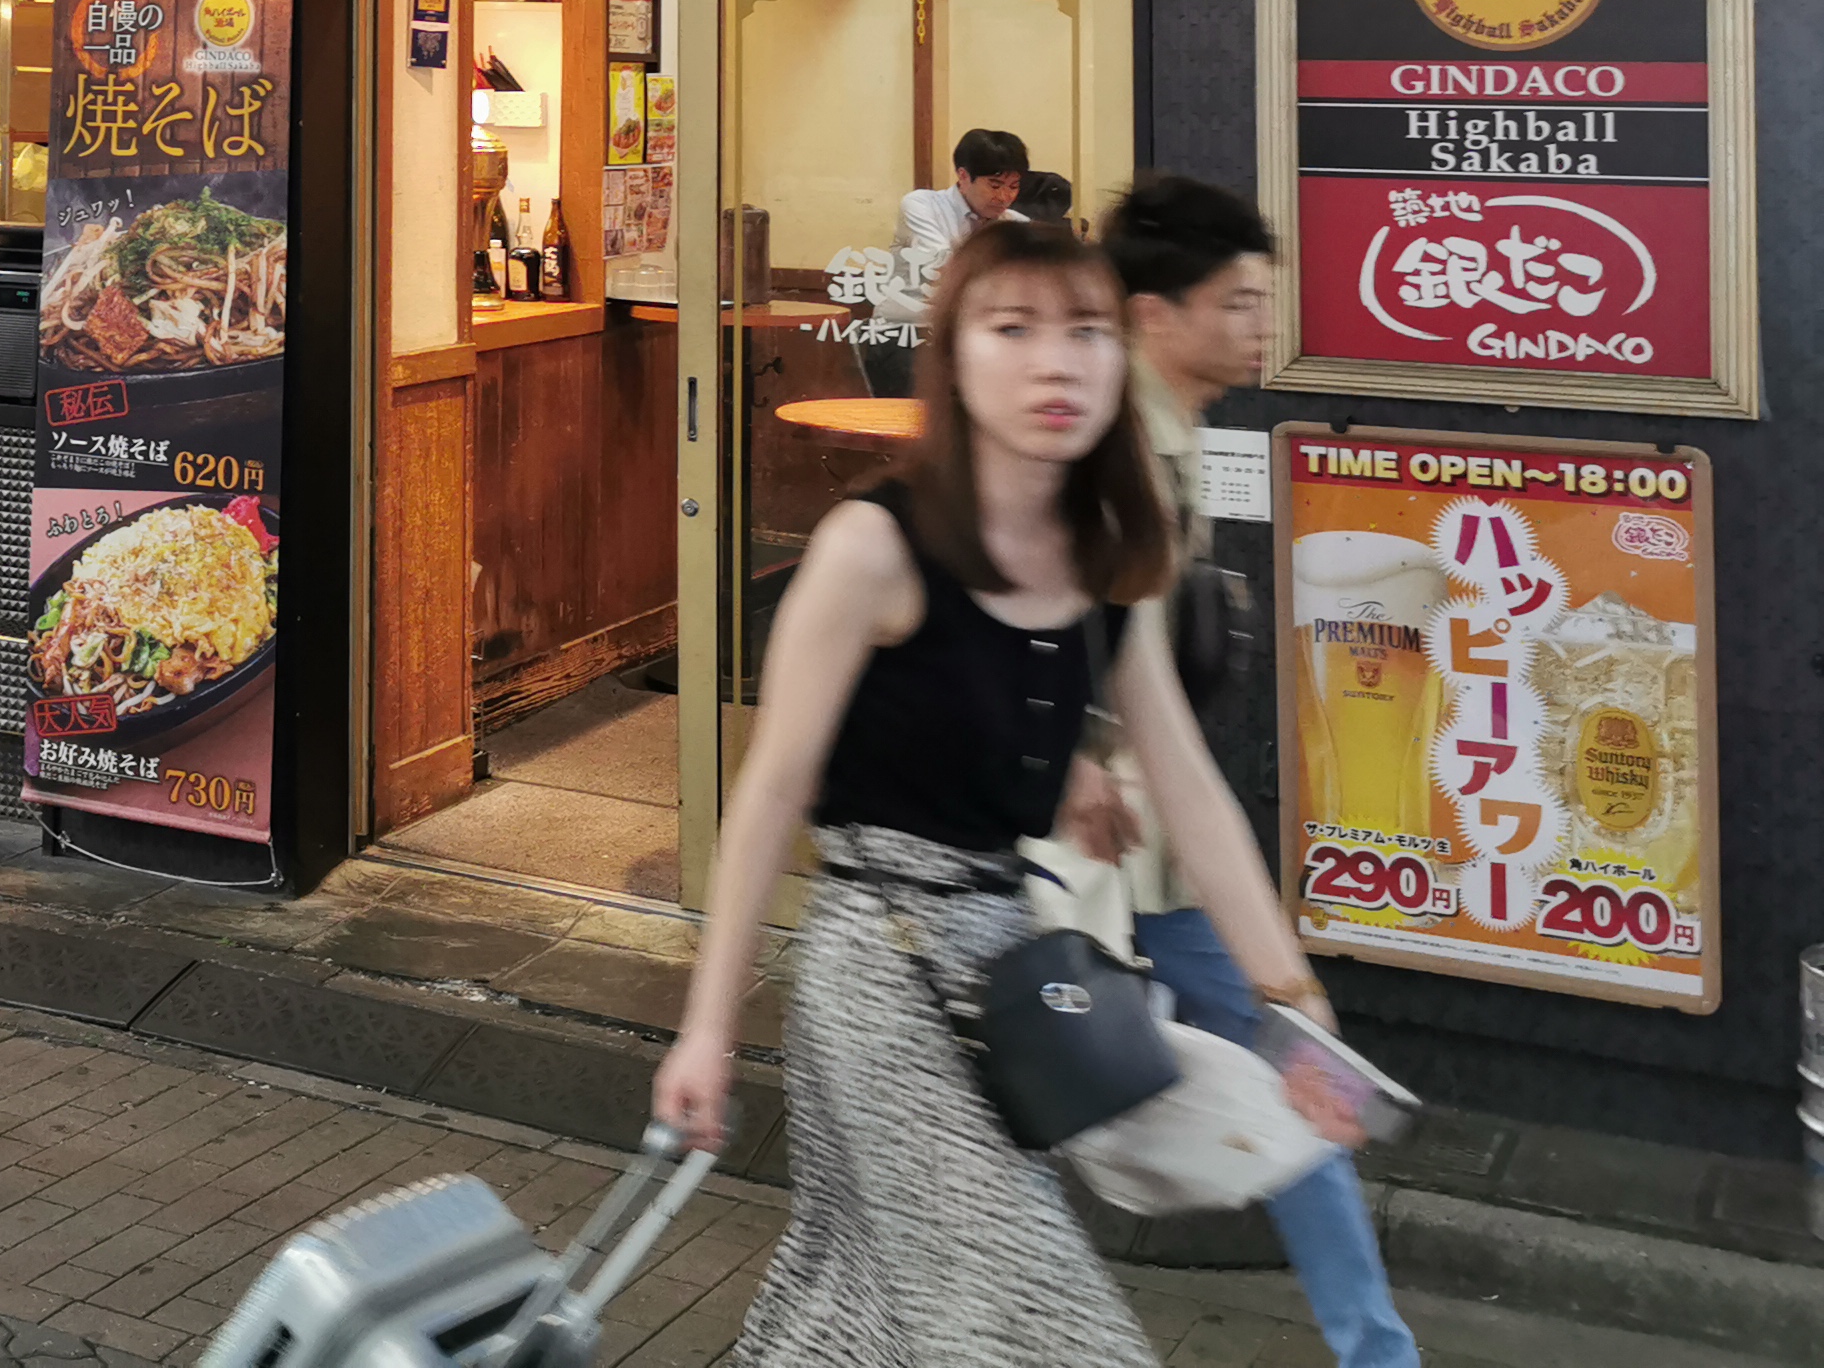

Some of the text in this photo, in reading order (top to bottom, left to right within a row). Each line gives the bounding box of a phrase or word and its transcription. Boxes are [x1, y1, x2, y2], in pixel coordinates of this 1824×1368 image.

[87, 0, 163, 32] 自慢の
[84, 34, 136, 65] 一品
[195, 51, 251, 61] GINDACO
[1390, 64, 1625, 98] GINDACO
[63, 73, 274, 159] 焼そば
[1405, 109, 1618, 151] Highball
[1431, 142, 1600, 176] Sakaba
[1388, 188, 1484, 228] 築地
[1391, 225, 1607, 318] 銀だこ
[1467, 323, 1654, 364] GINDACO
[52, 431, 171, 462] ソース焼そば
[1300, 444, 1399, 481] TIME
[175, 451, 264, 490] 620円
[1338, 597, 1394, 621] The
[1314, 618, 1421, 653] PREMIUM
[1450, 513, 1553, 922] ハッピーアワー
[40, 739, 160, 778] お好み焼そば
[1586, 765, 1650, 790] Whisky
[165, 769, 255, 815] 730円
[1311, 846, 1451, 910] 290円
[1569, 858, 1655, 880] 角ハイボール
[1542, 879, 1695, 946] 200円
